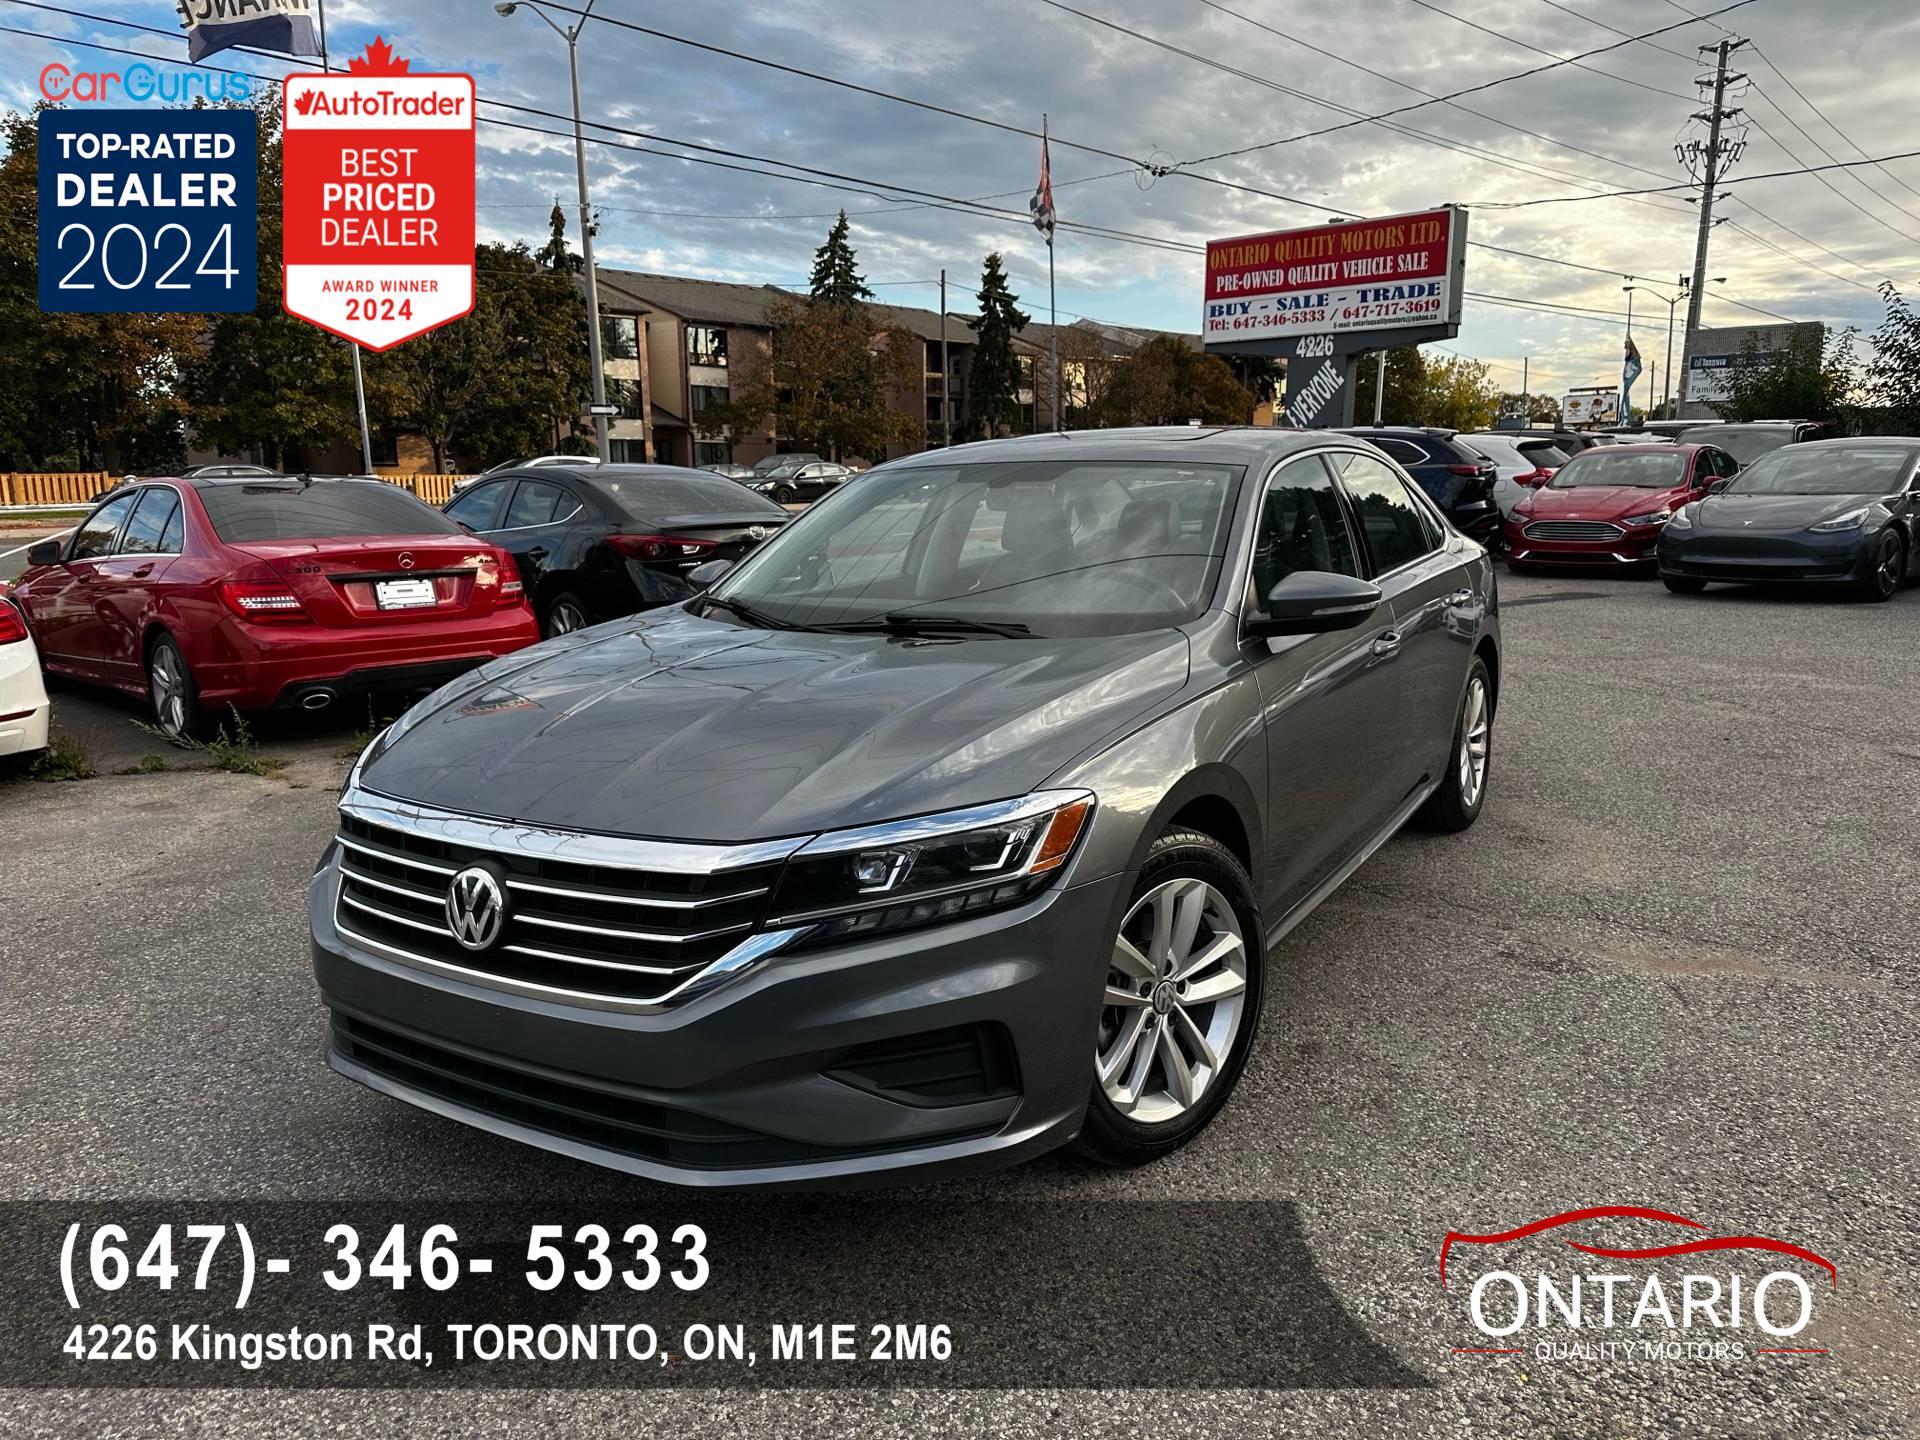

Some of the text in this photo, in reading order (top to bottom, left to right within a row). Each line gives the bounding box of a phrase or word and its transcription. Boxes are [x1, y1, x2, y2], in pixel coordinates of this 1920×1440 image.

[1210, 220, 1445, 271] ONTARIO QUALITY MOTORS LTD.
[1216, 251, 1429, 293] PRE-OWNED QUALITY VEHICLE SALE
[1209, 301, 1252, 318] BUY
[1277, 293, 1330, 312] SALE
[1356, 282, 1441, 304] TRADE
[1209, 318, 1230, 331] Tel:
[1233, 308, 1326, 330] 647-346-5333
[1342, 298, 1441, 320] 647-717-3619
[1296, 334, 1334, 358] 4226
[1286, 359, 1345, 428] EVERYONE
